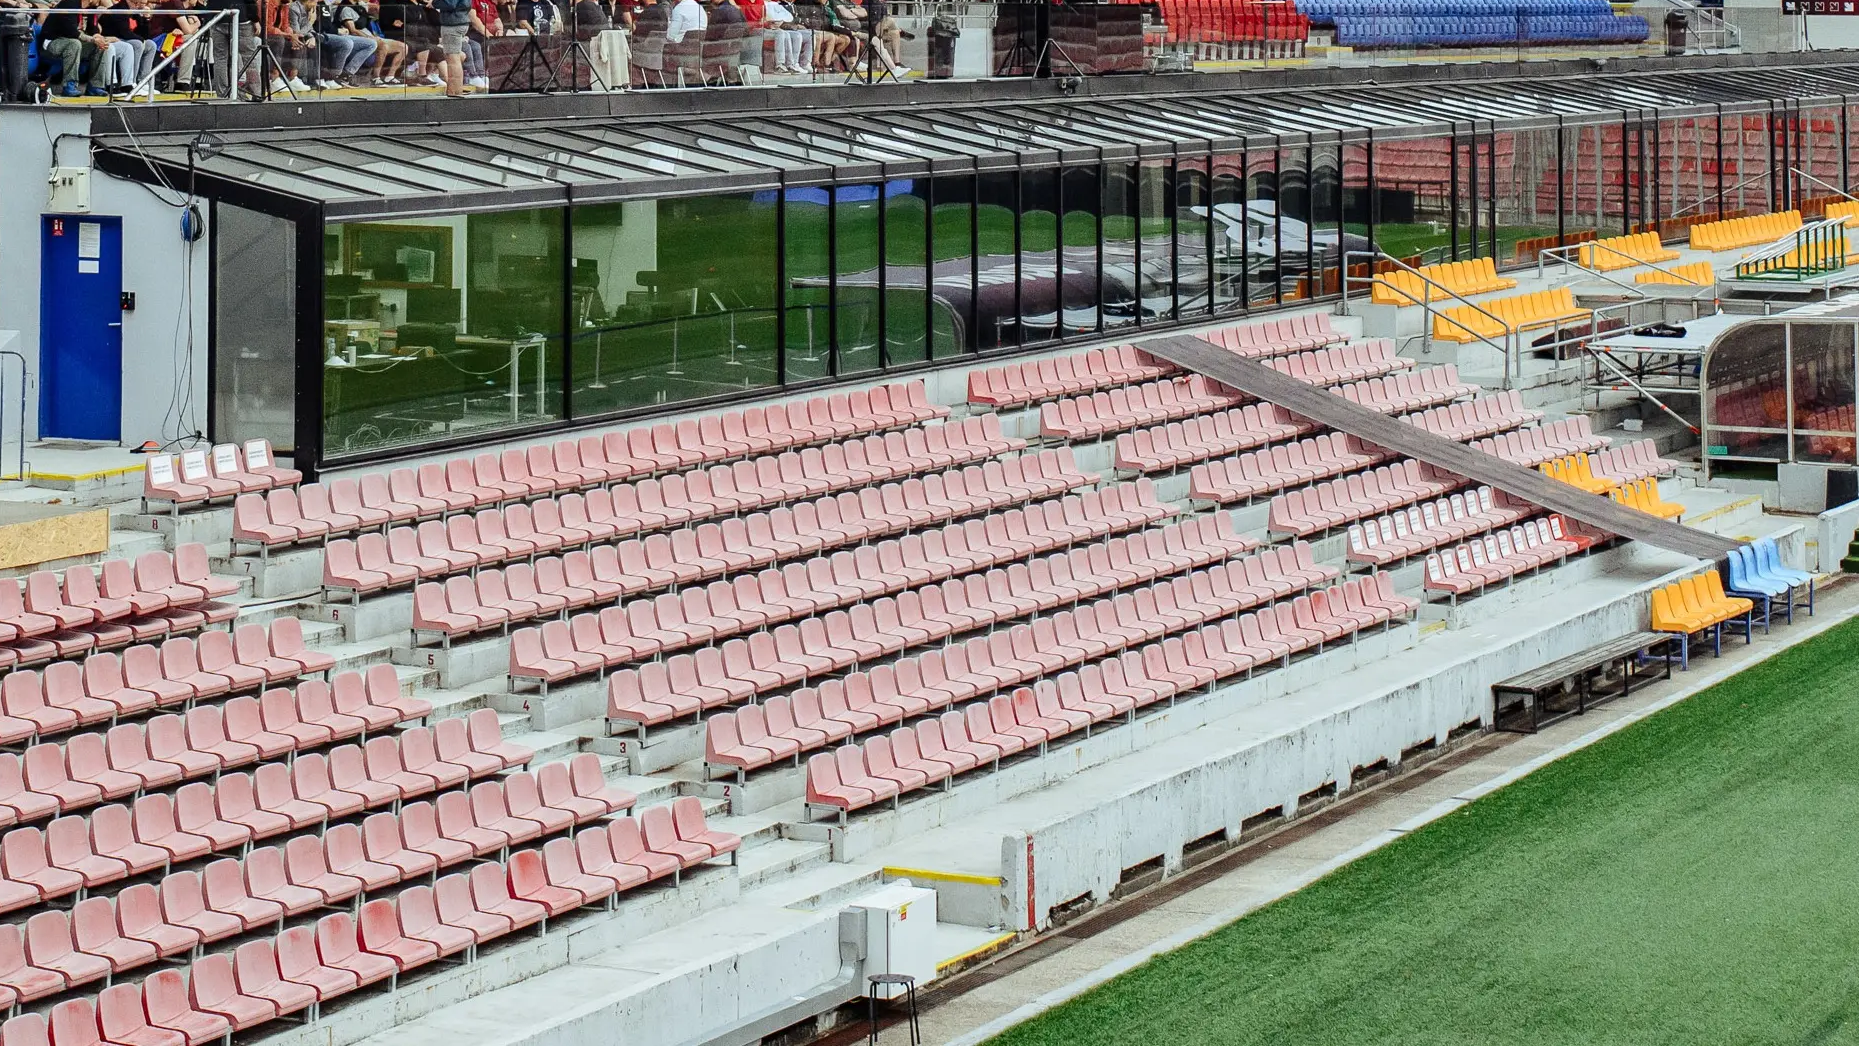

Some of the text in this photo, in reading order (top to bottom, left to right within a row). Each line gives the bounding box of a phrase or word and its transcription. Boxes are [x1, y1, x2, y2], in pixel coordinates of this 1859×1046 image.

[152, 518, 158, 530] 8
[244, 562, 251, 573] 7
[332, 609, 339, 621] 6
[427, 653, 434, 665] 5
[523, 699, 530, 711] 4
[620, 742, 626, 753] 3
[723, 785, 730, 797] 2
[827, 828, 832, 840] 1
